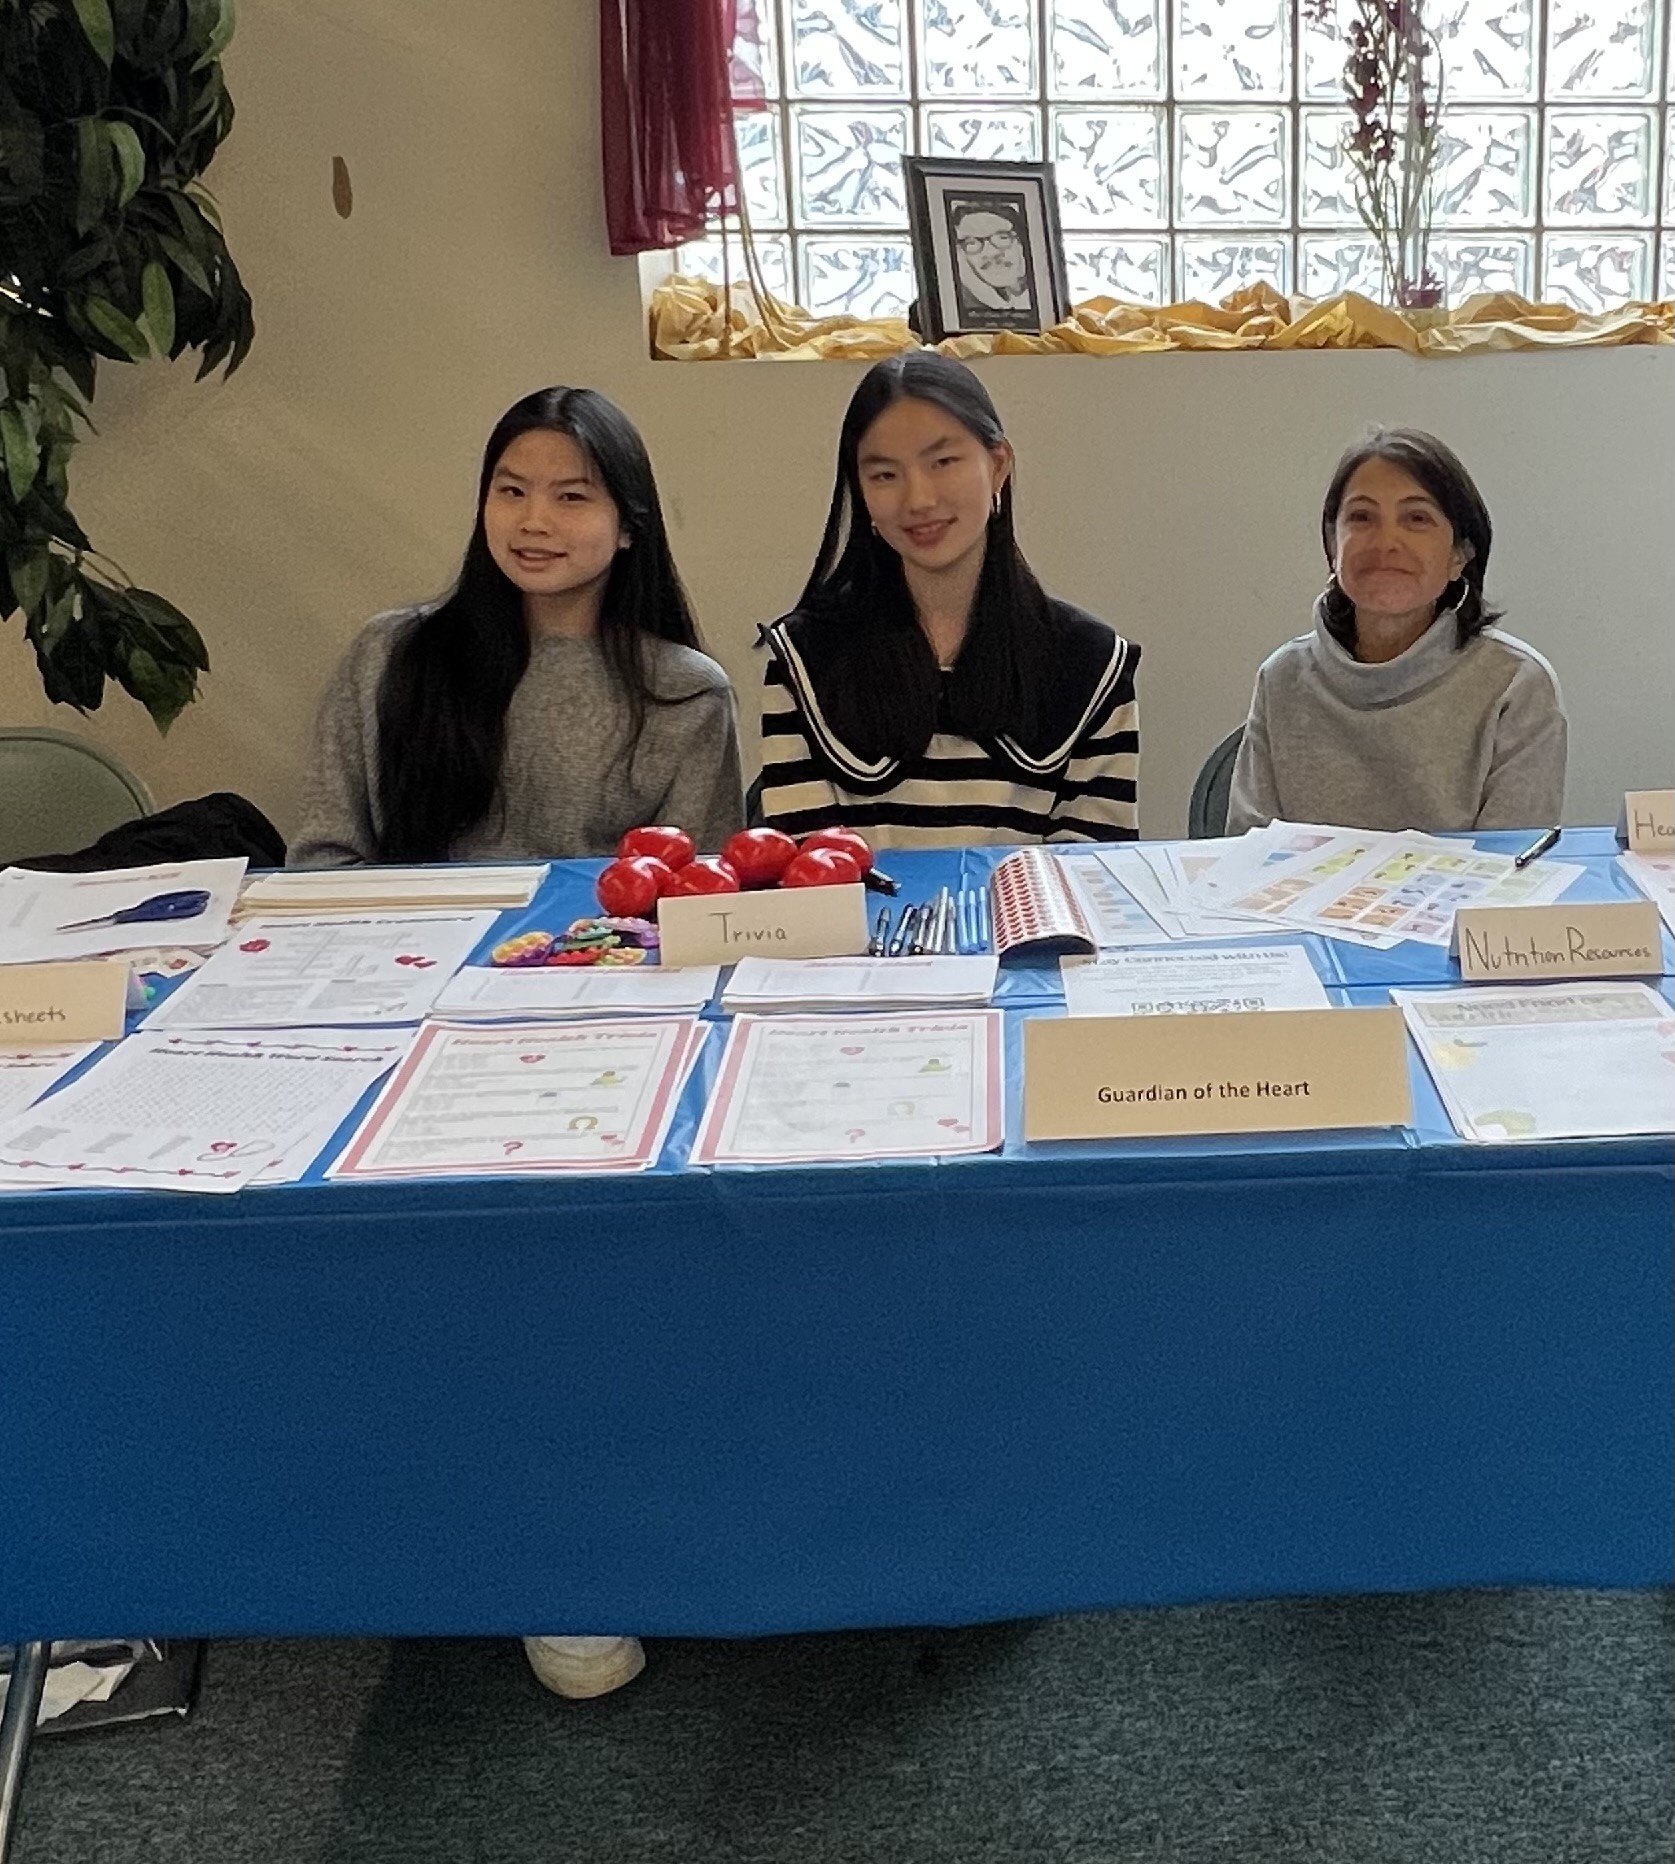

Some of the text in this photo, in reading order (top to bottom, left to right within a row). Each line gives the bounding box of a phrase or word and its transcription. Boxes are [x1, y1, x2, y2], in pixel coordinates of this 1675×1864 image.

[707, 911, 787, 943] Trivia
[0, 1006, 66, 1023] sheets
[1098, 1081, 1310, 1103] Guardian of the Heart
